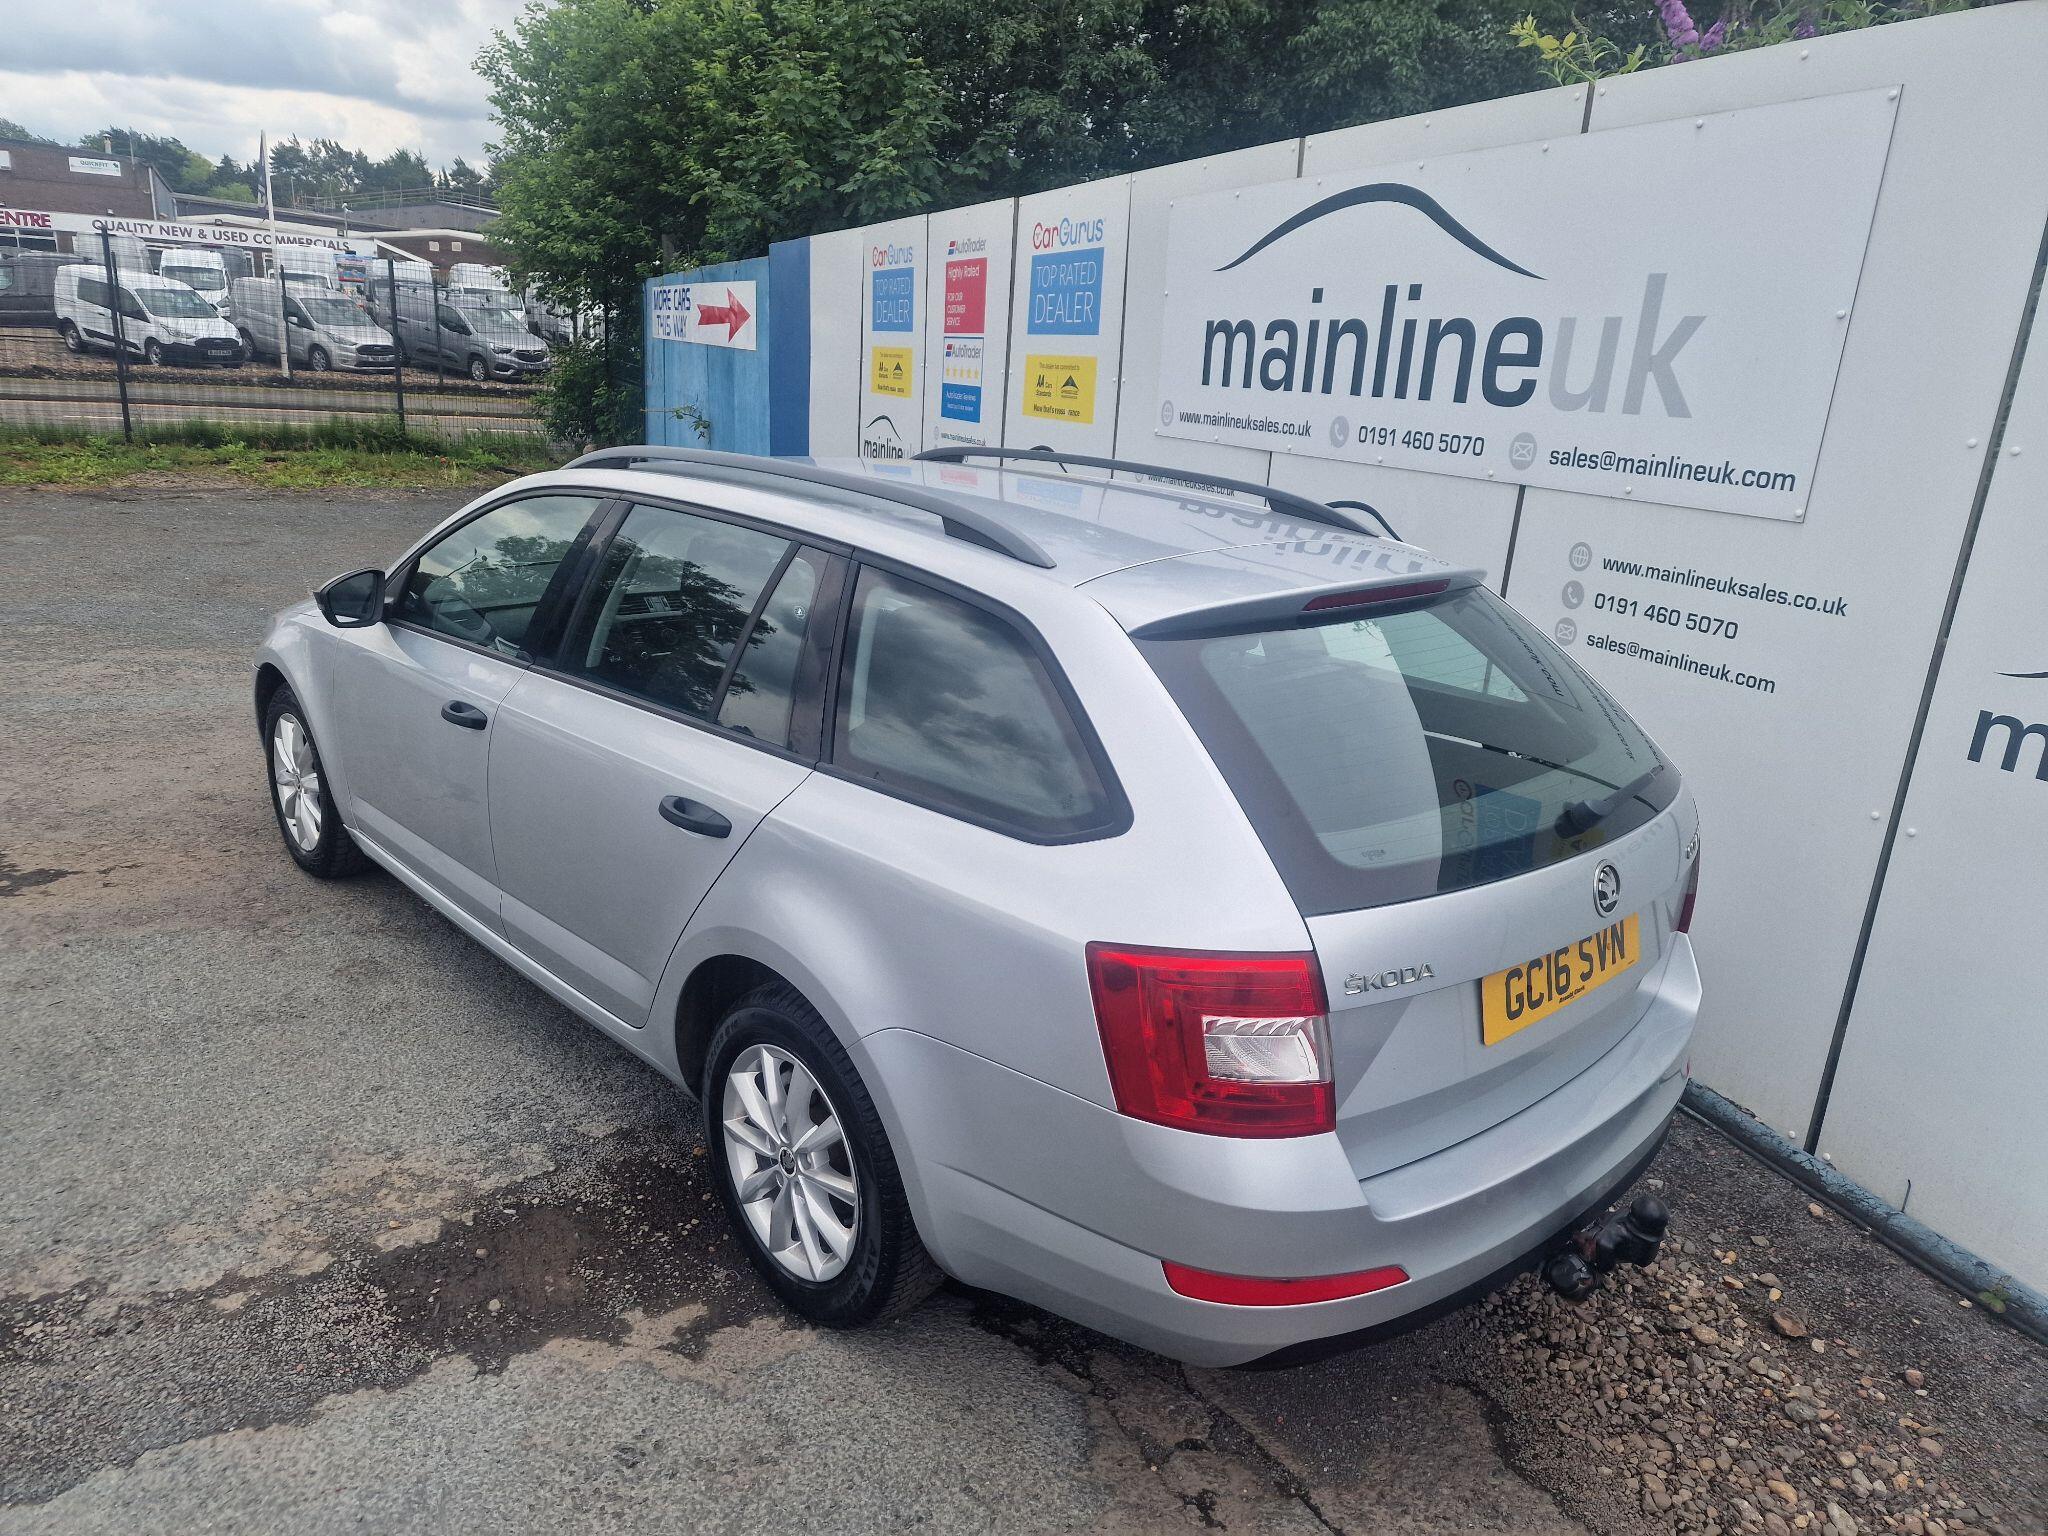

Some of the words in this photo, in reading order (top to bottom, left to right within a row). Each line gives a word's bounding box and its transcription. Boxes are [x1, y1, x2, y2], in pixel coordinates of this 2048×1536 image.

[92, 219, 154, 235] QUALITY
[159, 225, 193, 238] NEW
[198, 228, 207, 240] &
[213, 230, 249, 244] USED
[1032, 217, 1104, 250] CarGurus
[872, 244, 913, 267] CarGurus
[876, 278, 887, 296] TOP
[948, 266, 964, 281] Highly
[964, 264, 980, 277] Rated
[1036, 264, 1058, 288] TOP
[1059, 261, 1097, 286] RATED
[653, 288, 671, 311] MORE
[674, 287, 691, 311] CARS
[876, 299, 910, 323] DEALER
[1035, 291, 1094, 324] DEALER
[656, 314, 671, 337] THIS
[673, 314, 688, 338] WAY
[946, 316, 960, 326] SERVICE
[1201, 272, 1708, 419] mainlineuk
[1179, 410, 1312, 438] www.mainlineuksales.co.uk
[1358, 425, 1396, 446] 0191
[1401, 429, 1434, 451] 460
[1439, 433, 1485, 457] 5070
[1549, 446, 1796, 492] sales@mainlineuk.com
[1602, 557, 1848, 618] www.mainlineuksales.co.uk
[1594, 593, 1638, 618] 0191
[1644, 604, 1681, 627] 460
[1685, 612, 1739, 640] 5070
[1586, 632, 1776, 694] sales@mainlineuk.com
[1344, 962, 1435, 996] ŠKODA
[1504, 946, 1571, 1021] GC16
[1578, 919, 1625, 982] SVN
